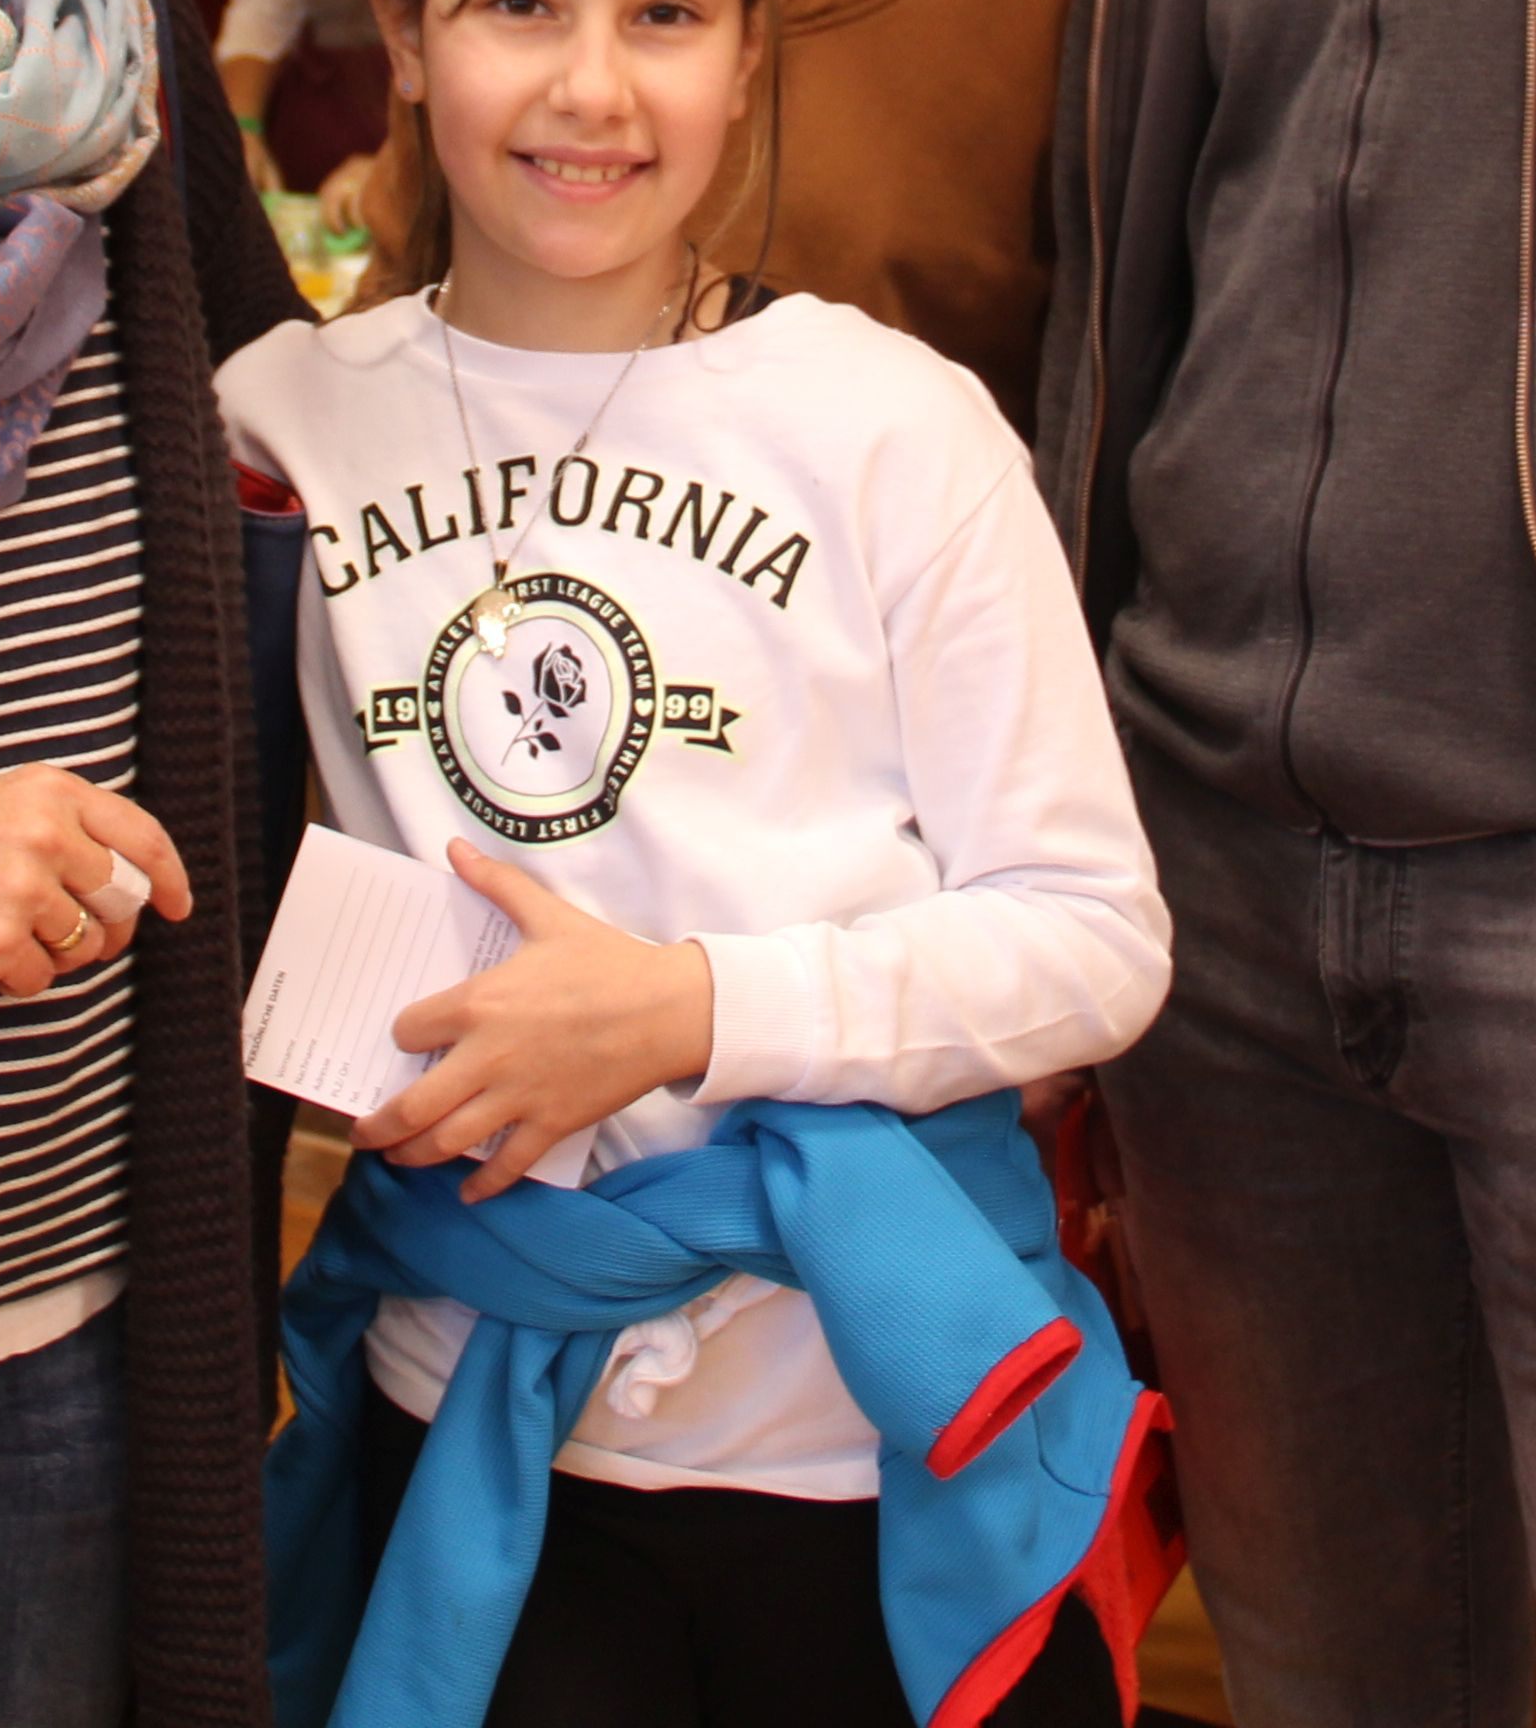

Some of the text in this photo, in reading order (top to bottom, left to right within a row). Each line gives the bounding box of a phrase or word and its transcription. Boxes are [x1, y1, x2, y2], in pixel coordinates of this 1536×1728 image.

[309, 454, 811, 609] CALIFORNIA
[557, 579, 626, 628] LEAGUE
[622, 630, 652, 689] TEAM
[375, 696, 417, 723] 19
[664, 694, 711, 721] 99
[430, 725, 462, 785] TEAM
[463, 788, 530, 838] LEAGUE
[537, 809, 603, 839] FIRST
[268, 969, 287, 1003] DATEN
